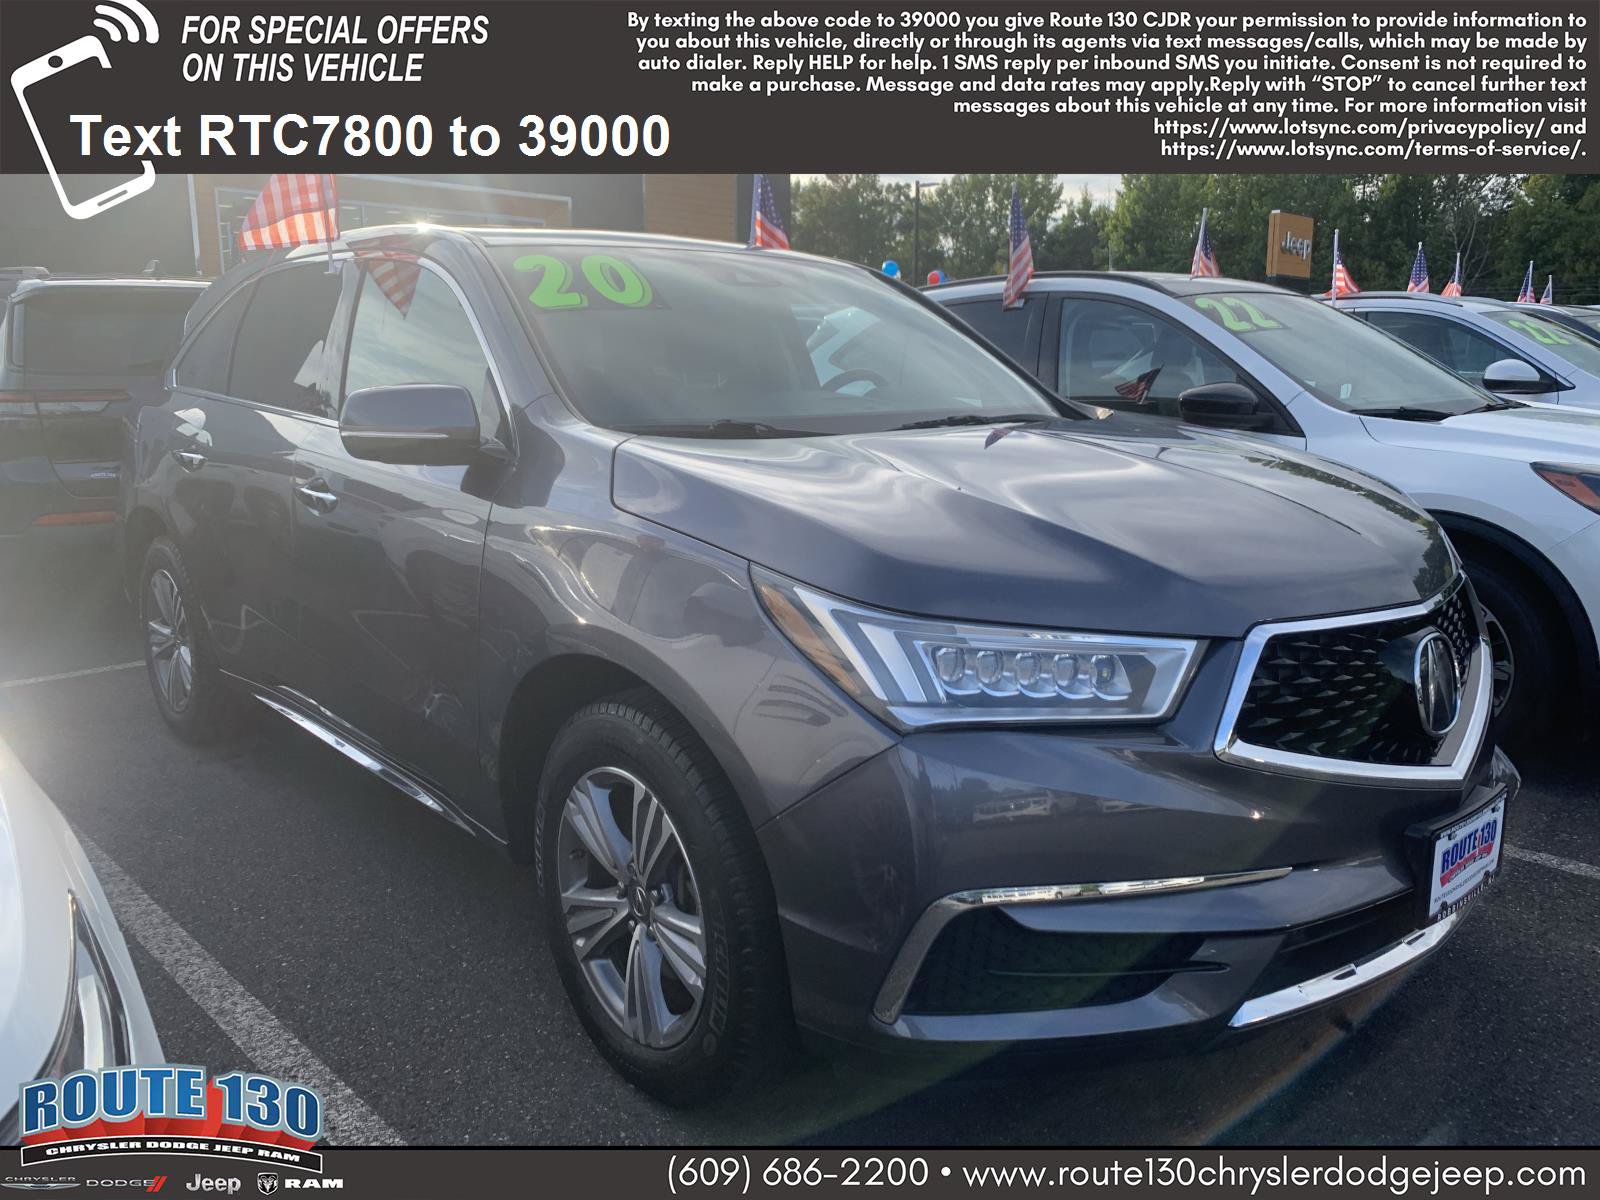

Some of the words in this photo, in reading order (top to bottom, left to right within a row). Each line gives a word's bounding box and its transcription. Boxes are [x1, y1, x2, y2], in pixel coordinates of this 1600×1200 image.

[1281, 230, 1311, 260] Jeep
[513, 254, 653, 309] 20
[1194, 296, 1282, 332] 22
[1441, 828, 1479, 874] ROUTE
[1480, 819, 1498, 847] 130
